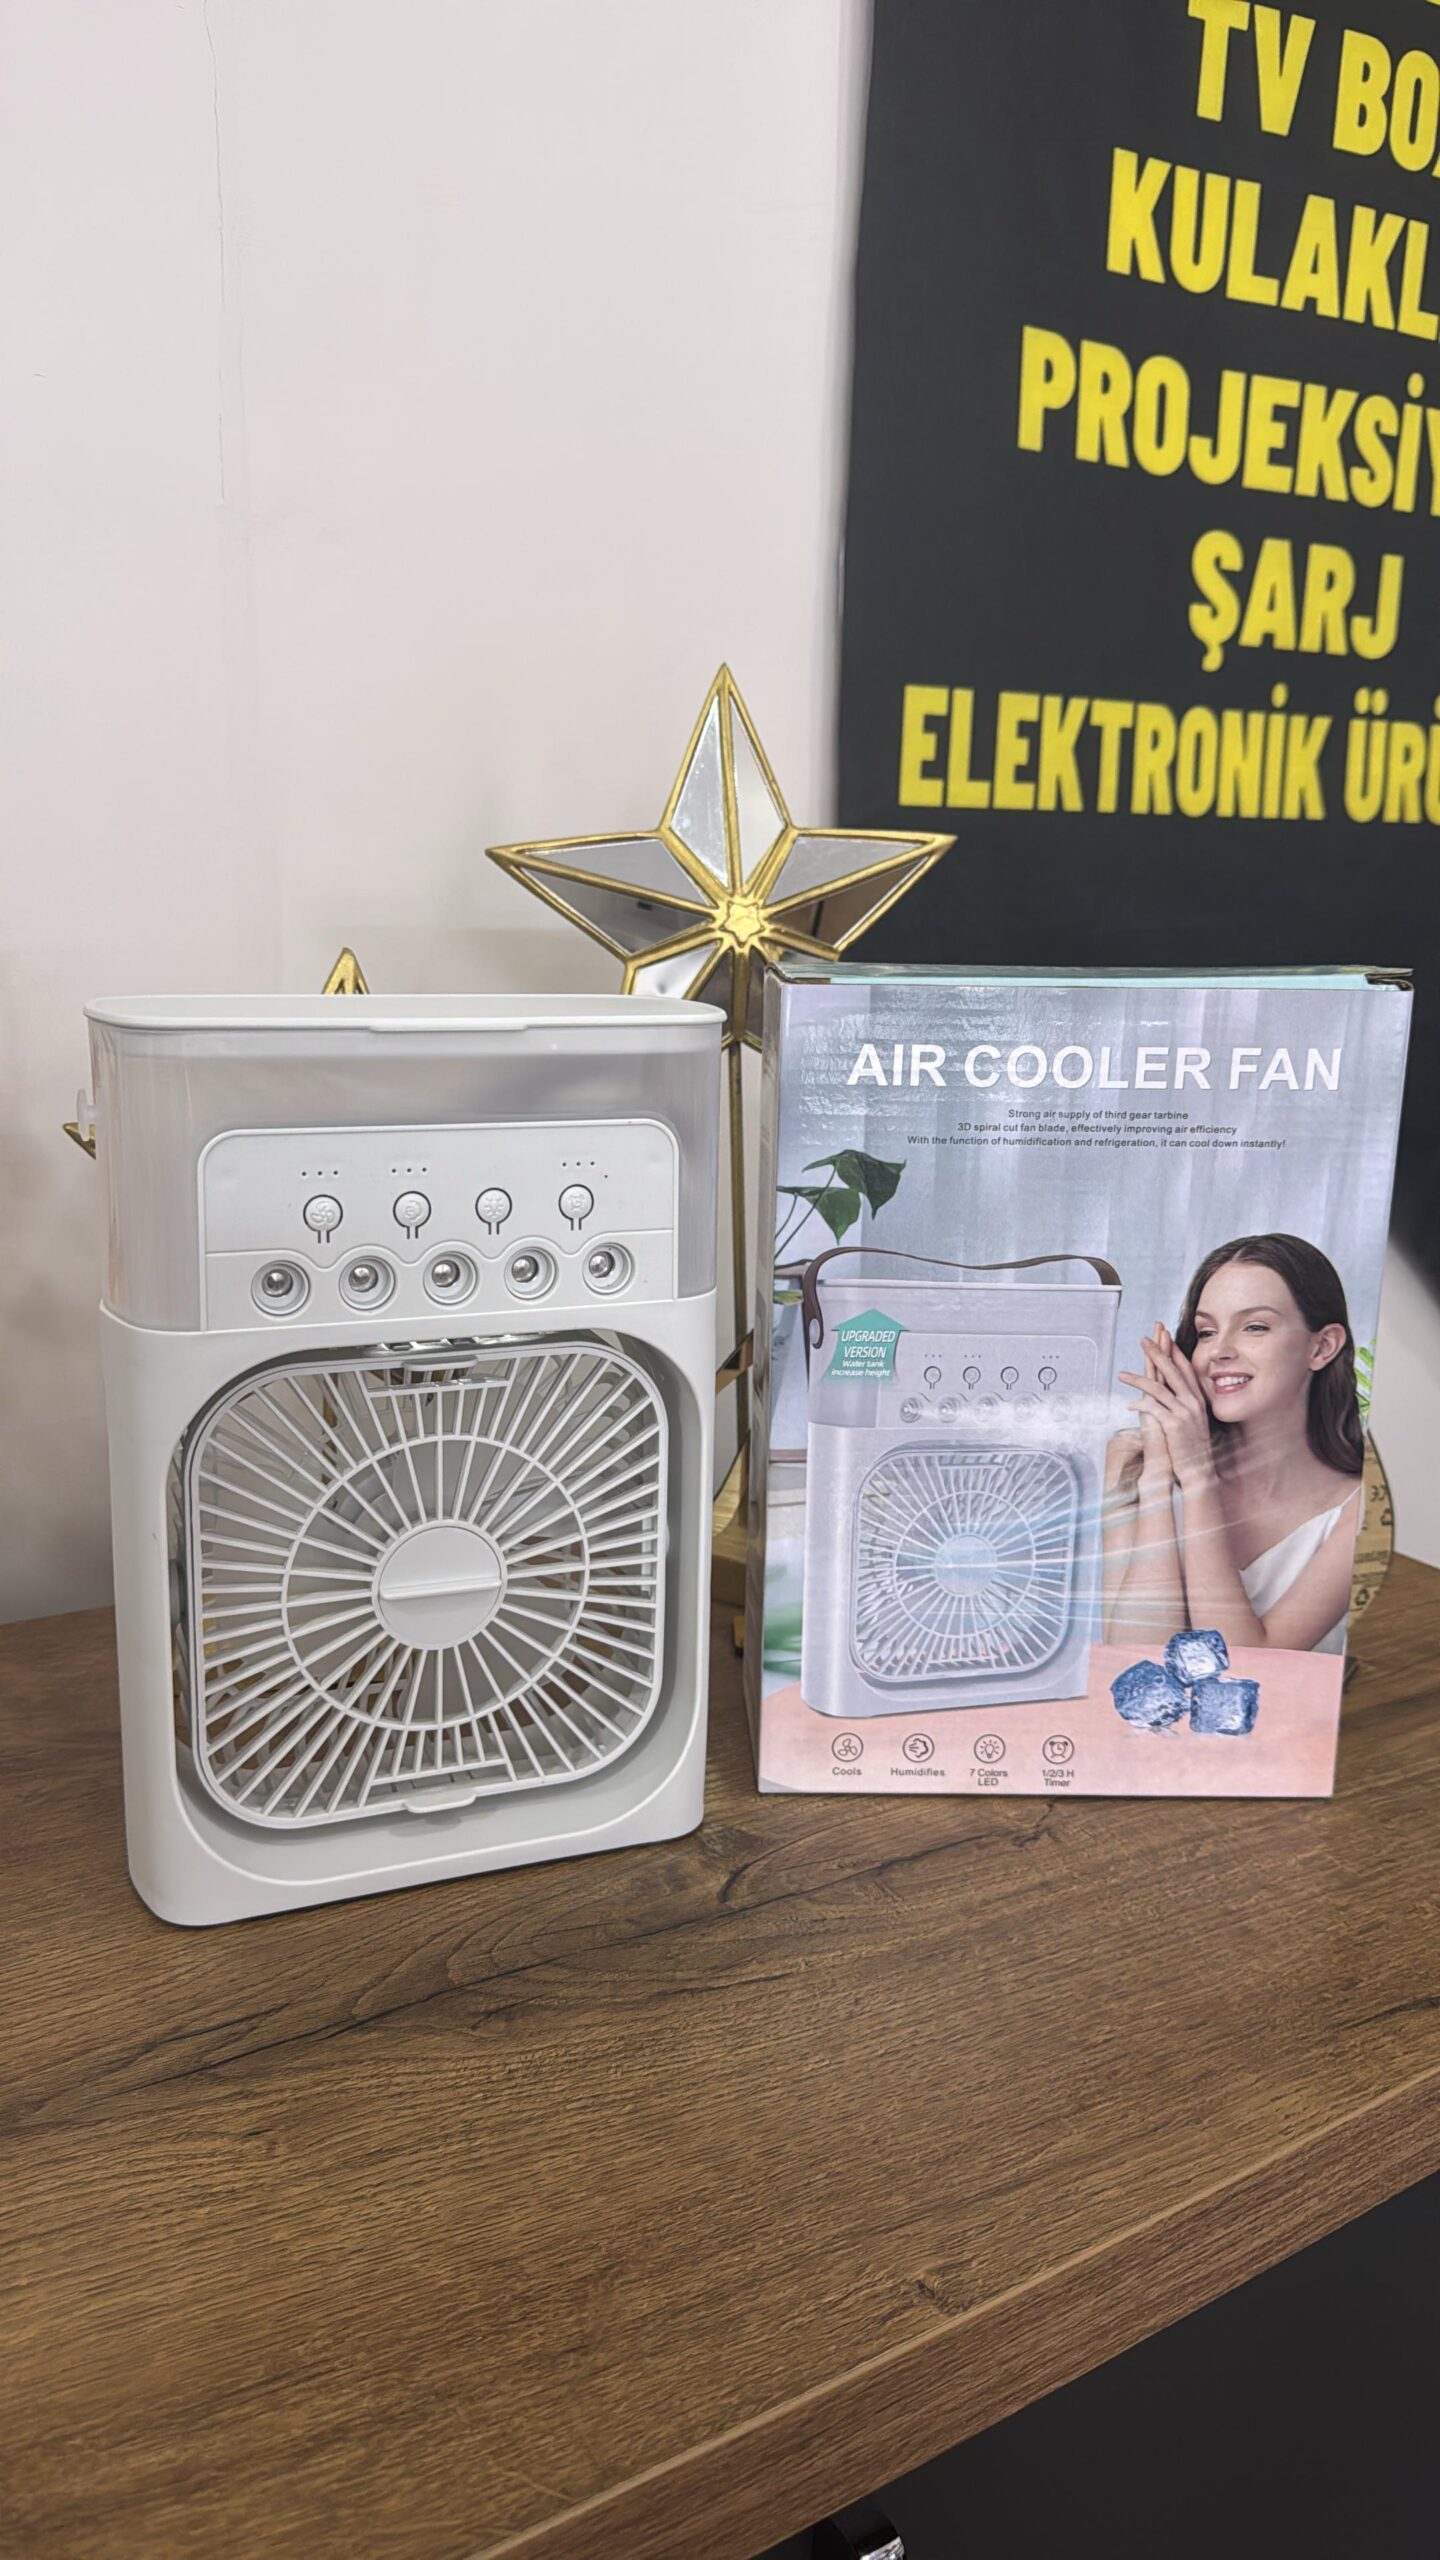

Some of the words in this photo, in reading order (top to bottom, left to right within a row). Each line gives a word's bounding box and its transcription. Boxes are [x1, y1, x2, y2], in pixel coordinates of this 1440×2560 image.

[1188, 0, 1316, 137] TV
[1333, 28, 1440, 179] BO
[1107, 147, 1440, 342] KULAKL
[1189, 530, 1404, 672] ŞARJ
[899, 684, 1333, 821] ELEKTRONİK
[846, 1044, 947, 1087] AIR
[964, 1045, 1212, 1090] COOLER
[1228, 1047, 1343, 1091] FAN
[1008, 1109, 1040, 1120] Strong
[1043, 1110, 1055, 1118] air
[1058, 1110, 1090, 1121] supply
[1092, 1111, 1103, 1119] of
[1104, 1111, 1127, 1120] third
[1129, 1112, 1151, 1121] gear
[1153, 1112, 1189, 1120] tarbine
[957, 1122, 971, 1131] 3D
[973, 1122, 1001, 1133] spiral
[1003, 1123, 1018, 1132] cut
[1020, 1123, 1036, 1132] fan
[1038, 1123, 1069, 1134] blade,
[1071, 1123, 1122, 1134] effectively
[1124, 1124, 1173, 1135] improving
[1174, 1125, 1188, 1134] air
[1190, 1125, 1237, 1135] efficiency
[907, 1135, 930, 1145] With
[931, 1136, 948, 1145] the
[949, 1135, 989, 1146] function
[991, 1136, 1001, 1146] of
[1003, 1136, 1072, 1147] humidification
[1074, 1137, 1093, 1147] and
[1094, 1138, 1158, 1148] refrigeration,
[1160, 1139, 1168, 1147] it
[1189, 1139, 1210, 1147] cool
[1212, 1139, 1239, 1148] down
[1240, 1140, 1286, 1149] instantly!
[841, 1330, 896, 1342] UPGRADED
[844, 1346, 887, 1358] VERSION
[831, 1368, 864, 1376] increase
[865, 1368, 891, 1377] height
[832, 1767, 862, 1776] Cools
[890, 1768, 945, 1777] Humidifies
[969, 1768, 976, 1777] 7
[977, 1768, 1008, 1777] Colors
[1042, 1769, 1064, 1778] 1/2/3
[1066, 1769, 1075, 1778] H
[977, 1778, 999, 1786] LED
[1045, 1778, 1071, 1787] Timer
